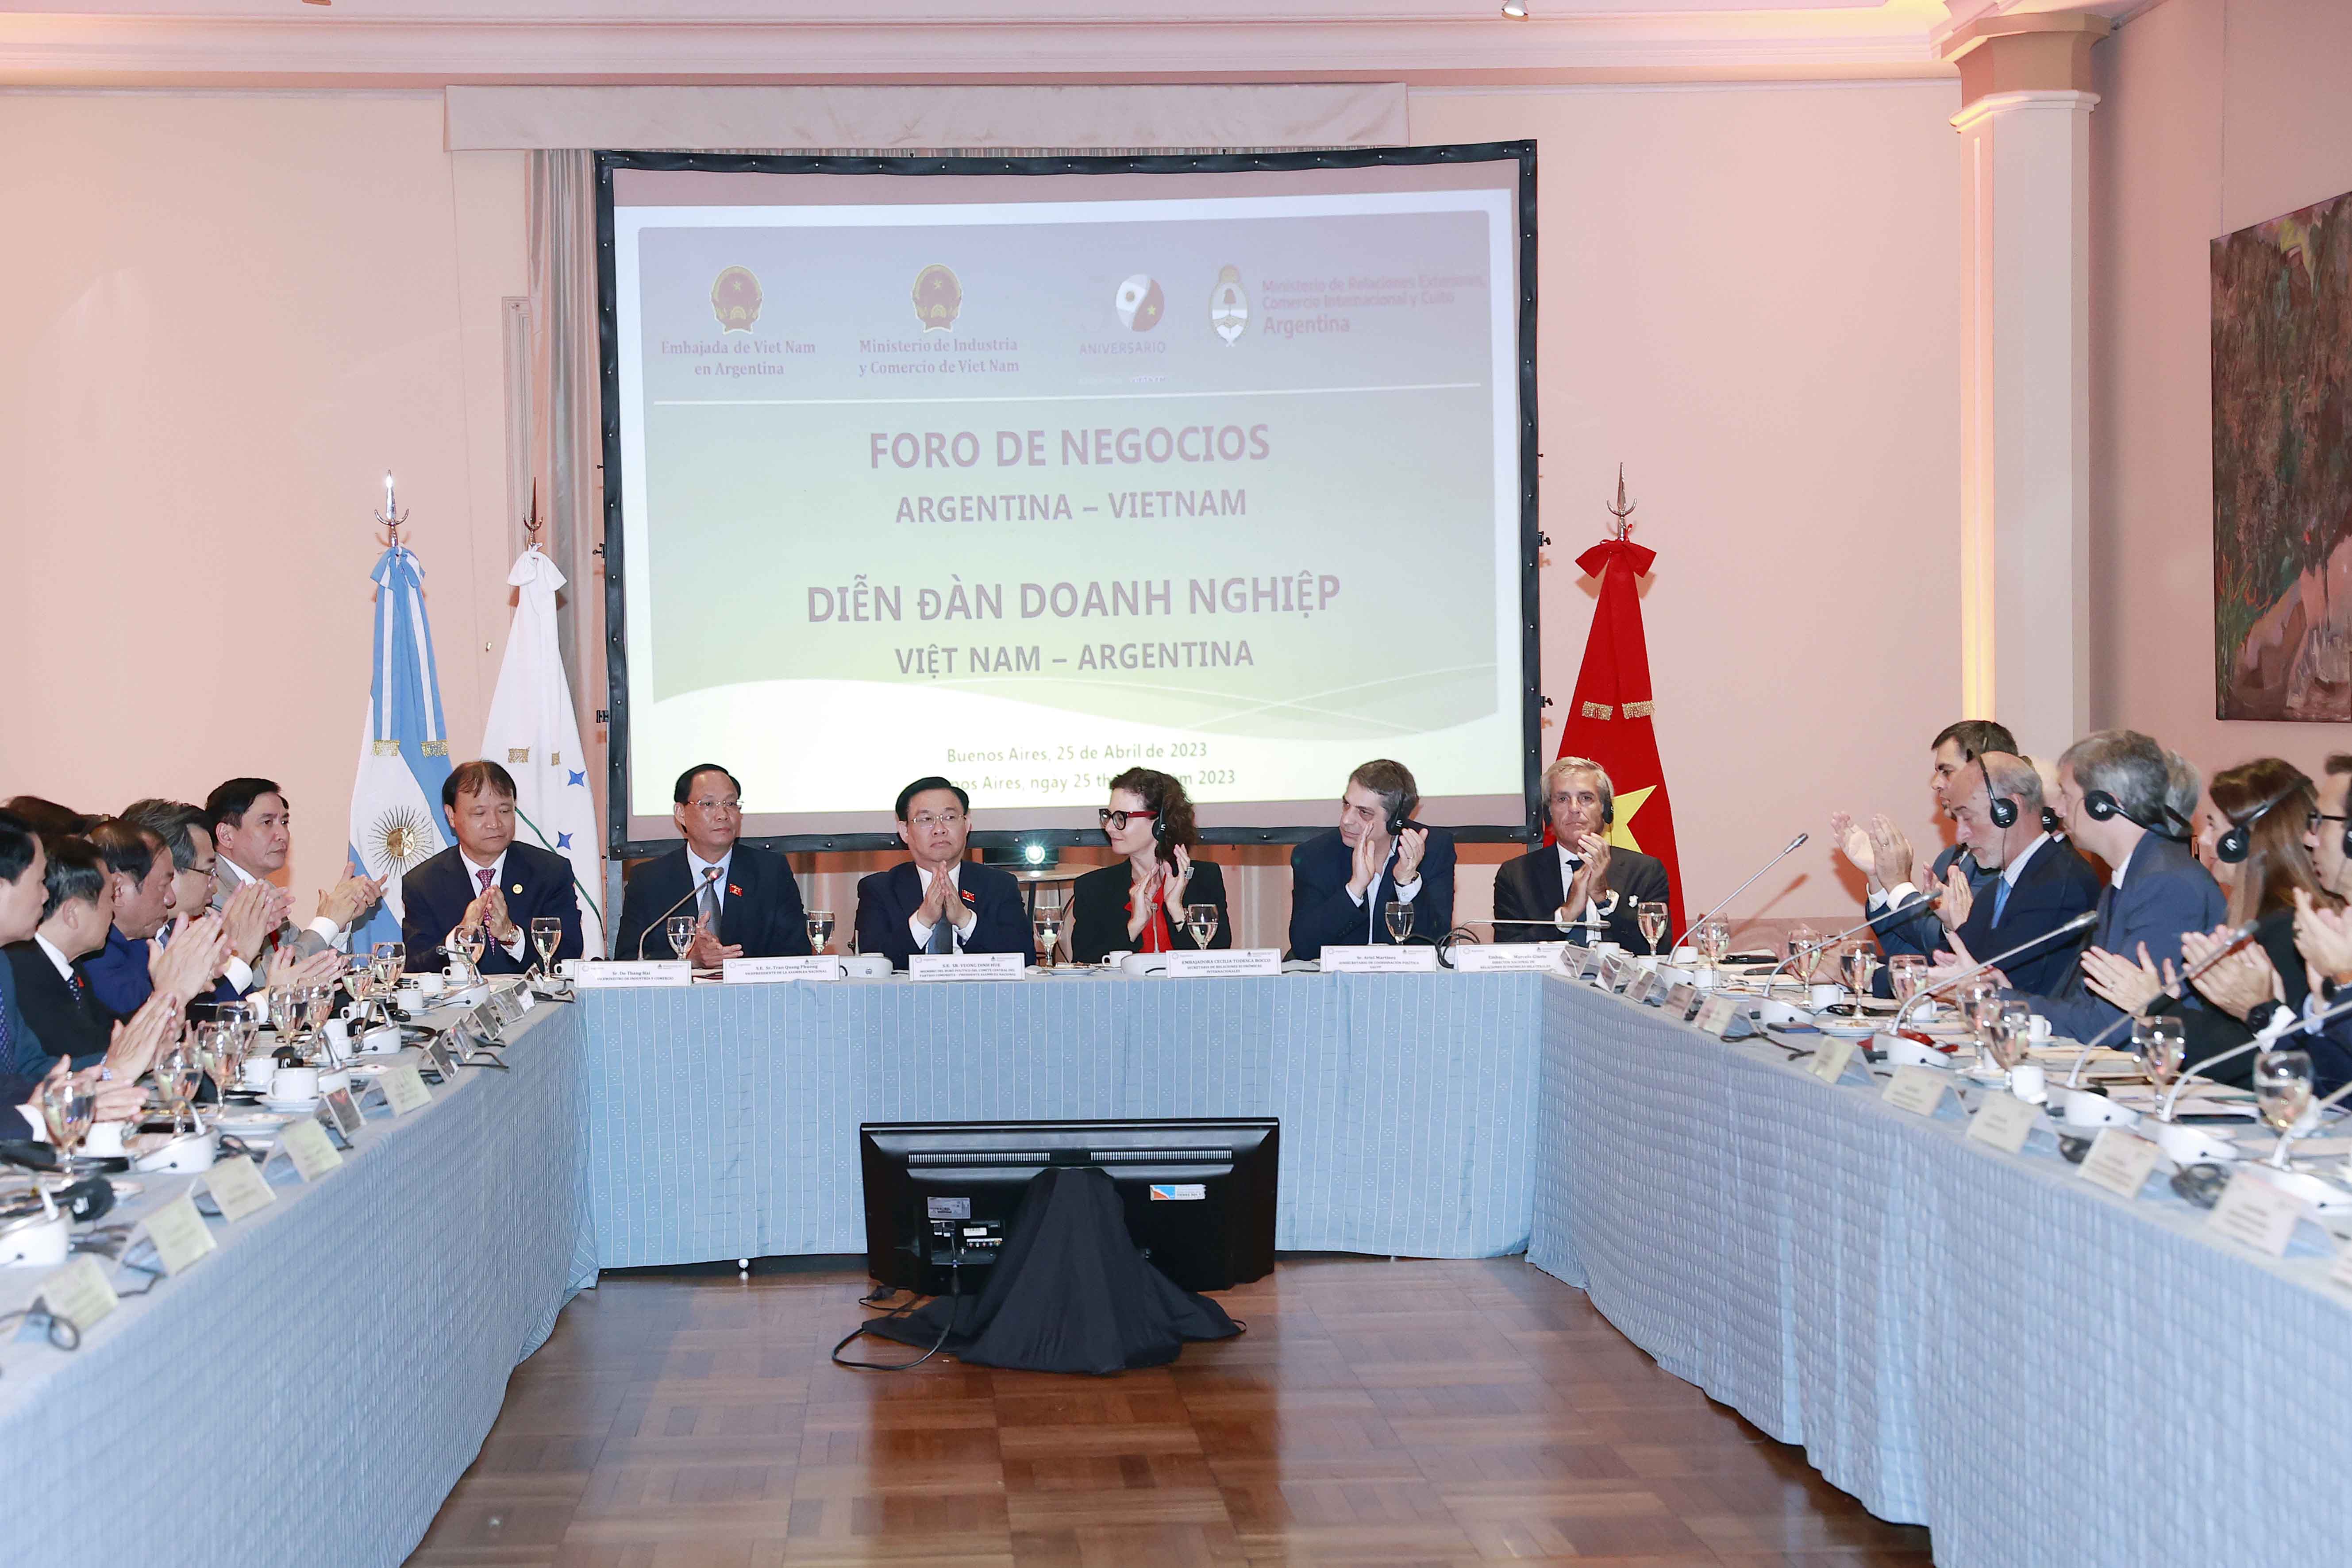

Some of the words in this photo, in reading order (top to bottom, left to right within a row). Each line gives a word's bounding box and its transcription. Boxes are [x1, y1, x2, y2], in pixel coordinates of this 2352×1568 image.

[1263, 315, 1350, 338] Argentina
[662, 341, 730, 356] Embajada
[734, 341, 750, 354] de
[754, 341, 782, 354] Viet
[786, 341, 816, 353] Nam
[860, 338, 930, 353] Ministerio
[934, 338, 950, 352] de
[954, 338, 1018, 351] Industria
[1080, 341, 1165, 354] ANIVERSARIO
[694, 366, 711, 375] en
[715, 362, 784, 378] Argentina
[858, 364, 867, 378] y
[870, 362, 935, 374] Comercio
[939, 360, 955, 373] de
[959, 359, 986, 373] Viet
[989, 359, 1019, 372] Nam
[870, 431, 979, 469] FORO
[996, 430, 1046, 467] DE
[1061, 424, 1270, 466] NEGOCIOS
[895, 493, 1073, 523] ARGENTINA
[1108, 489, 1246, 519] VIETNAM
[808, 574, 901, 622] DIỄN
[917, 574, 1003, 620] ĐÀN
[1020, 579, 1171, 618] DOANH
[1189, 570, 1340, 618] NGHIỆP
[895, 643, 958, 679] VIỆT
[970, 646, 1040, 673] NAM
[1078, 640, 1254, 670] ARGENTINA
[947, 748, 1004, 763] Buenos
[1009, 747, 1051, 762] Aires,
[1057, 745, 1074, 760] 25
[1080, 745, 1098, 759] de
[1104, 744, 1140, 759] Abril
[1146, 743, 1164, 758] de
[1170, 742, 1207, 757] 2023
[951, 778, 978, 790] nos
[983, 775, 1025, 791] Aires,
[1074, 773, 1091, 787] 25
[1199, 770, 1235, 785] 2023
